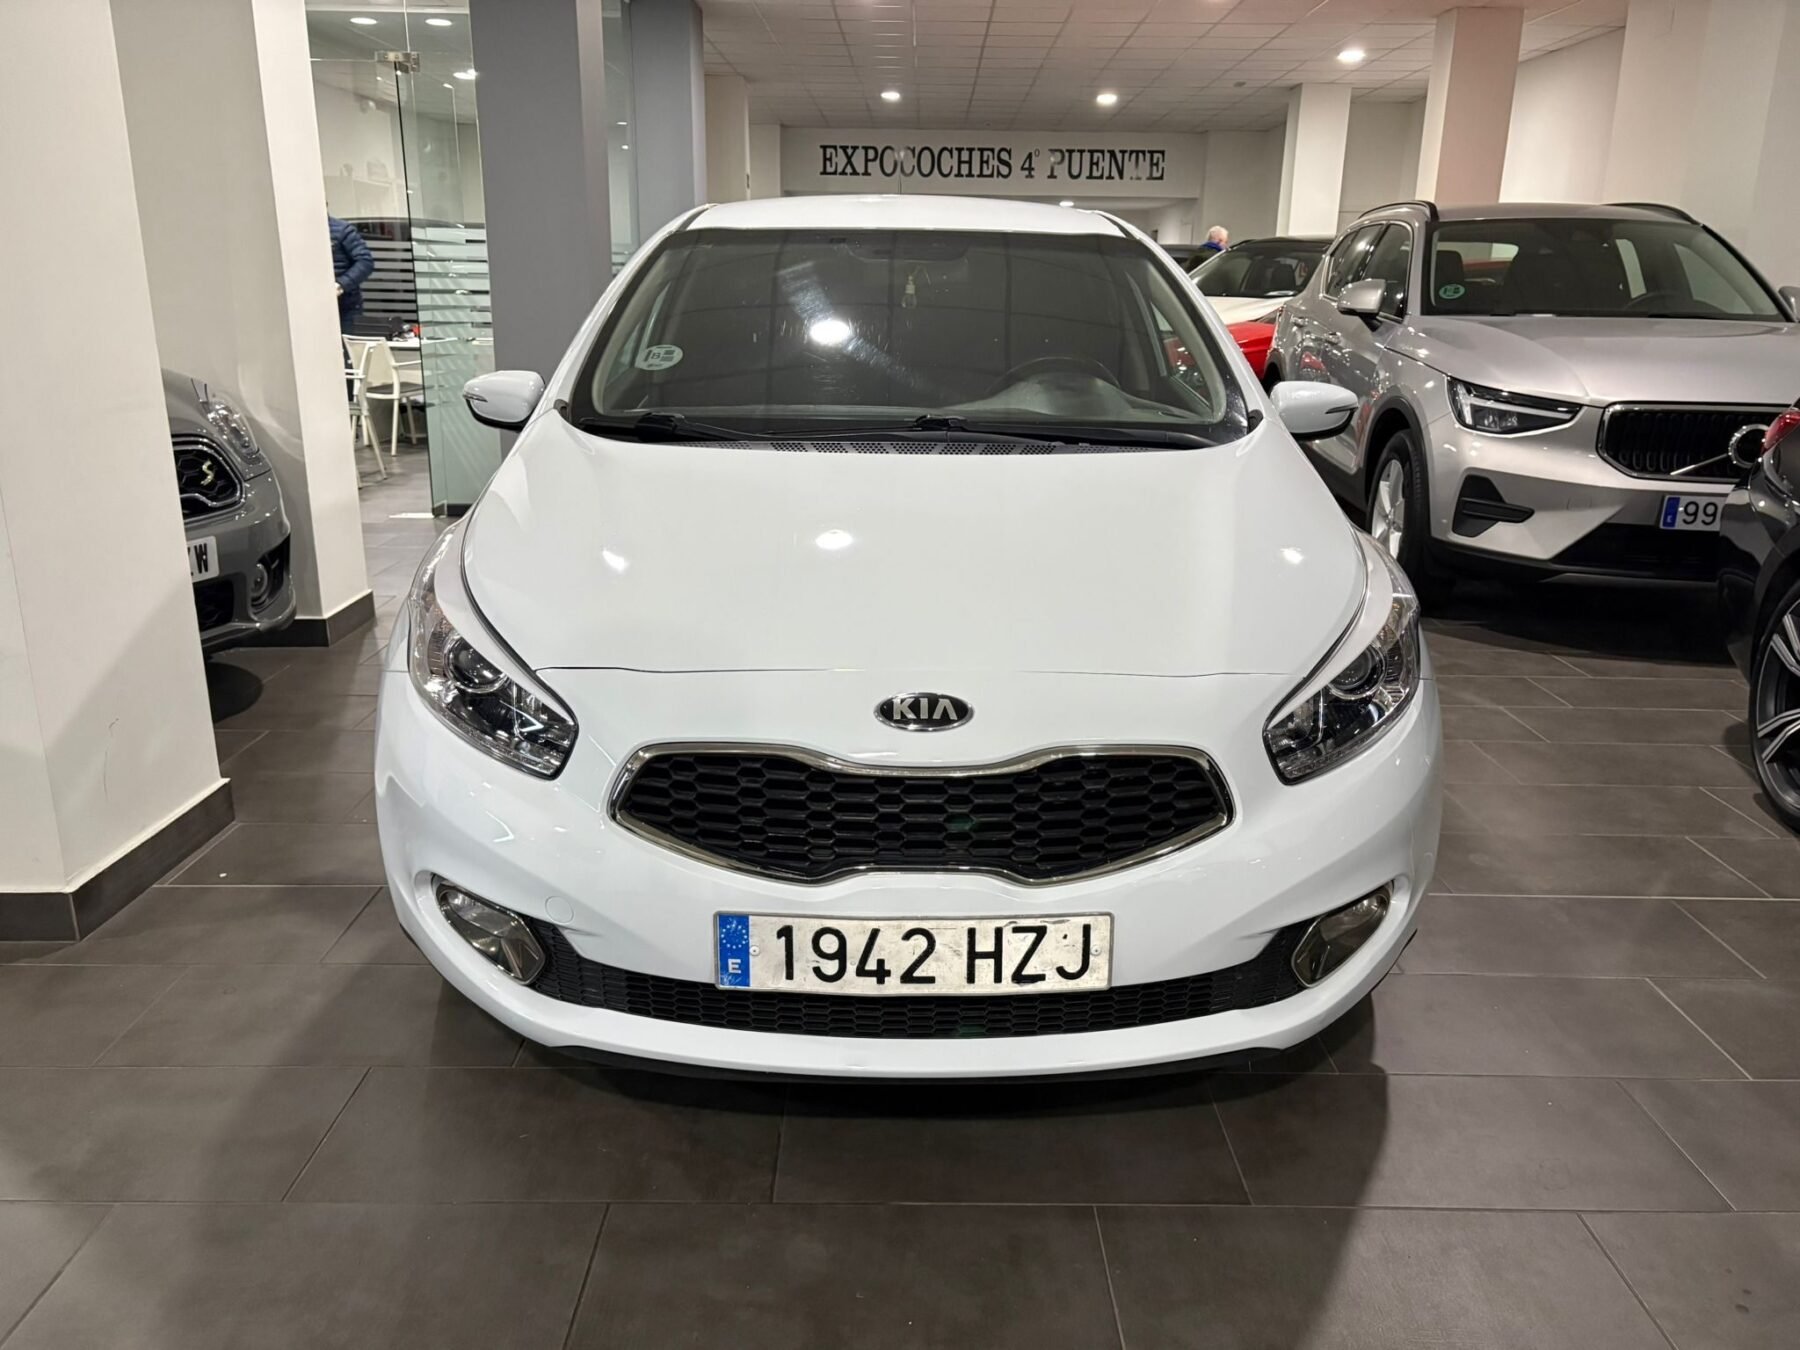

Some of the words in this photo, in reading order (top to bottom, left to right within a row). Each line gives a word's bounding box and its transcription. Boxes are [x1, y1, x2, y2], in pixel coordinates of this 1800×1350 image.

[819, 145, 1013, 180] EXPOCOCHES
[1047, 148, 1166, 181] PUENTE
[892, 697, 958, 720] KIA
[728, 958, 742, 974] E
[776, 924, 936, 985] 1942
[967, 923, 1092, 984] HZJ
